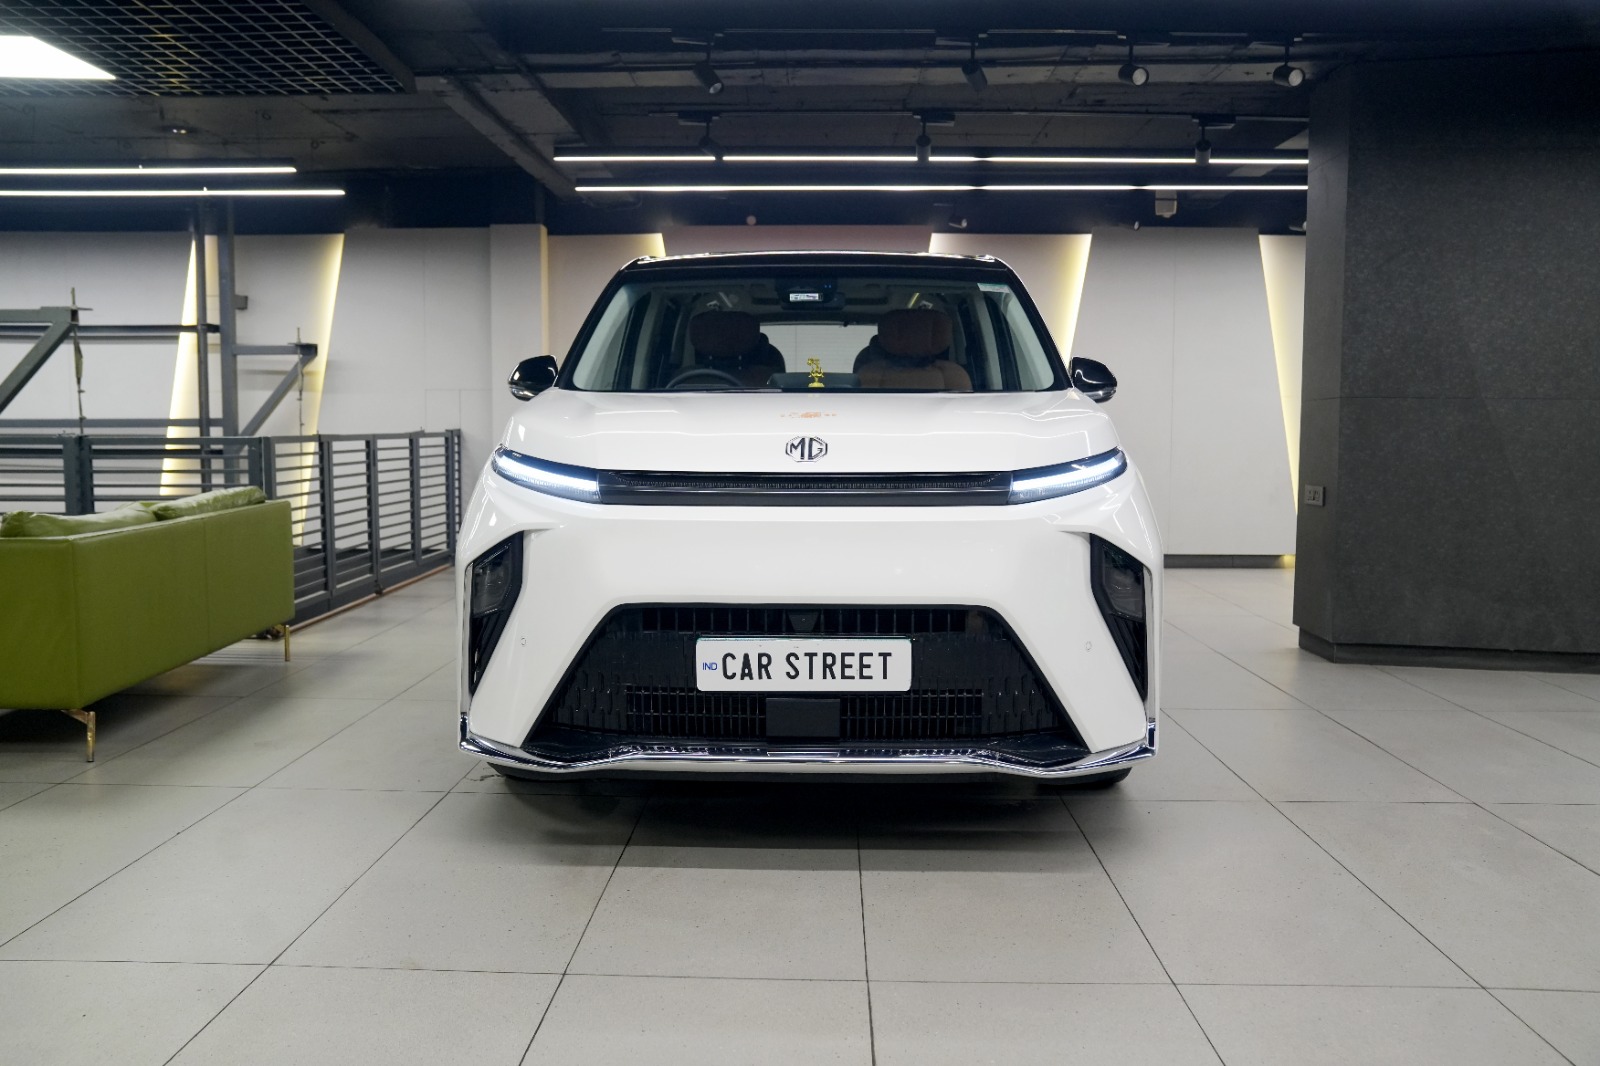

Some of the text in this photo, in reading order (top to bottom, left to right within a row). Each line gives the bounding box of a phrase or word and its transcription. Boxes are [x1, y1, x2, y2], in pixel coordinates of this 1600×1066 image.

[790, 437, 823, 460] MG
[702, 652, 893, 681] IND CAR STREET
